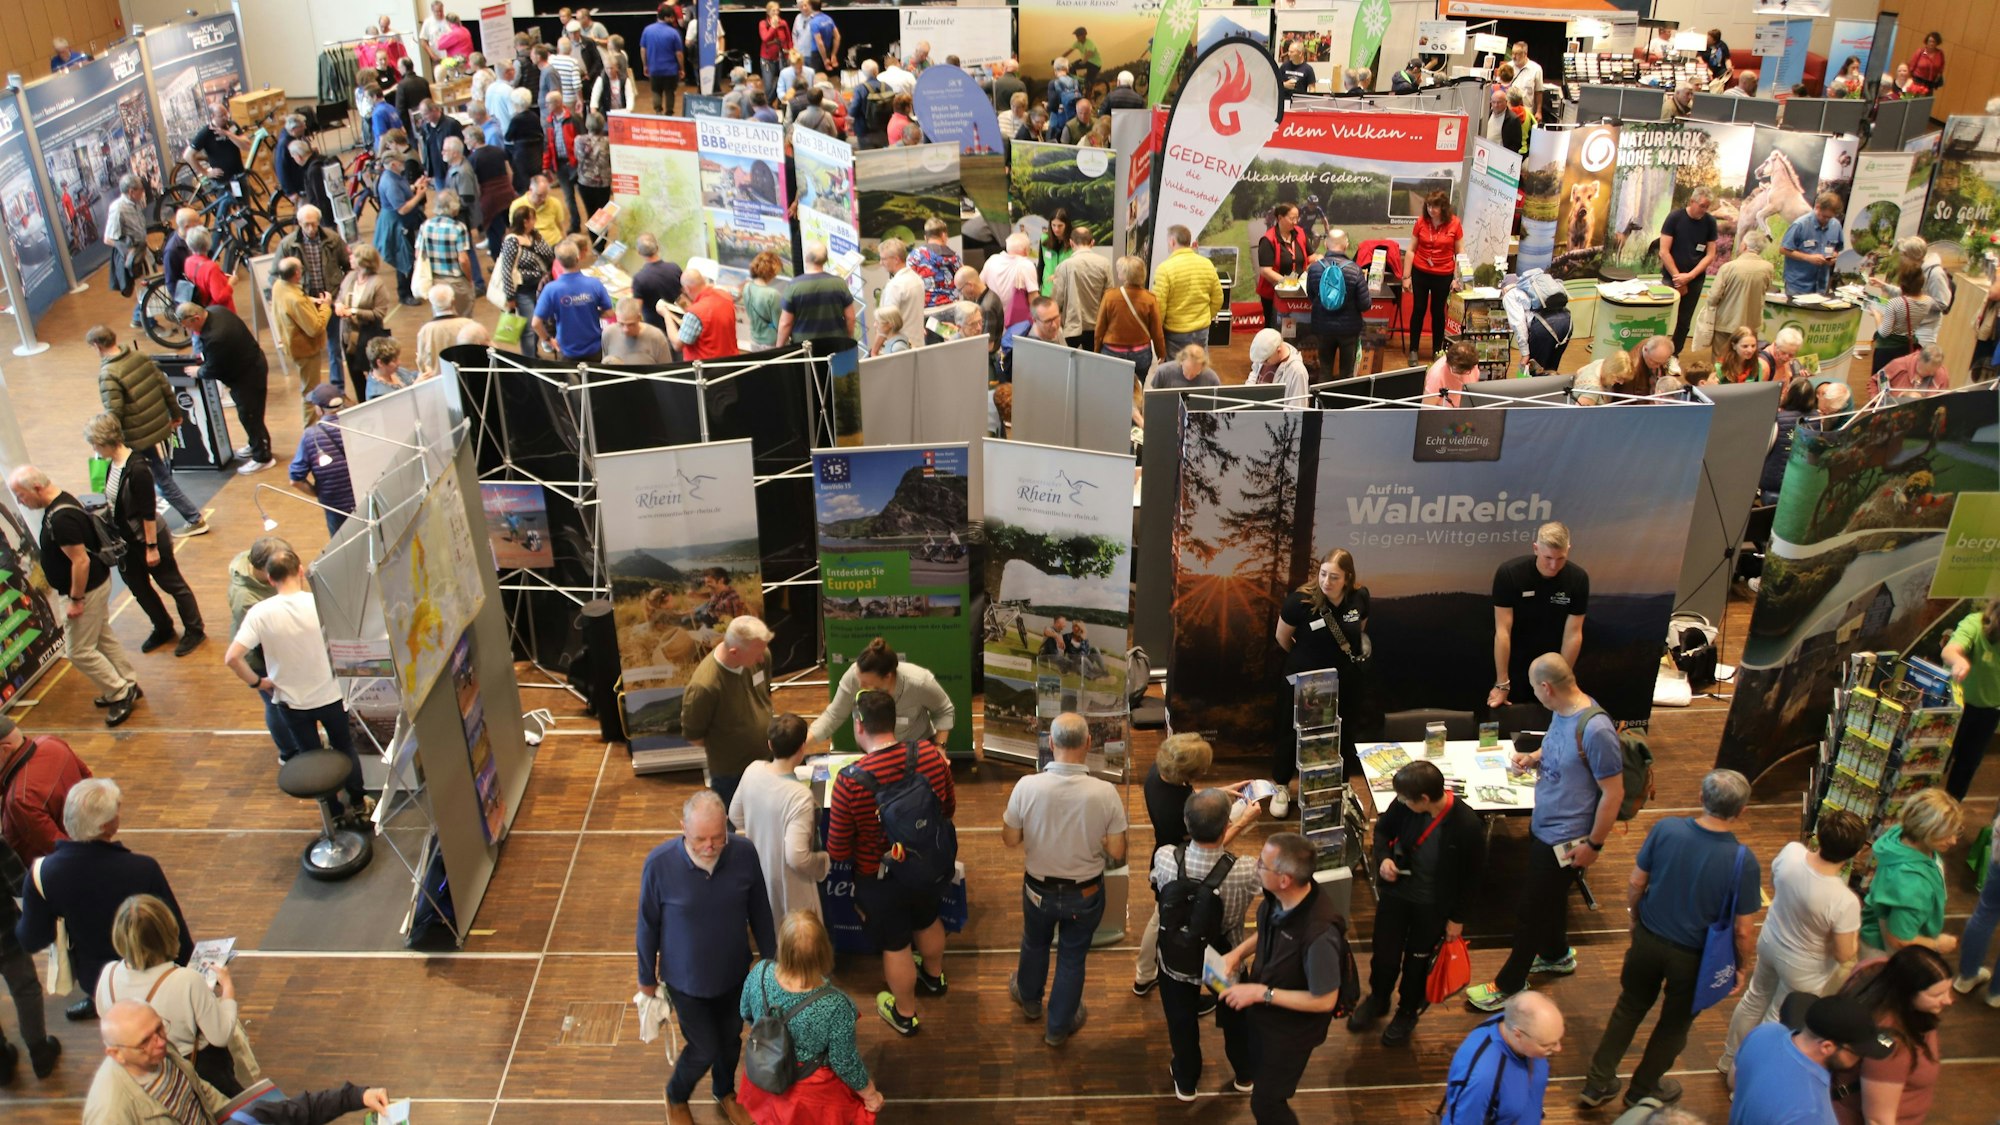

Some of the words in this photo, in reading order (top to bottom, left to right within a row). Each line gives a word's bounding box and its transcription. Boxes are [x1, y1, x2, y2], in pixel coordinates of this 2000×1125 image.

[904, 11, 955, 26] Tambiente
[192, 31, 225, 49] FELD
[113, 60, 136, 81] FELD
[701, 122, 721, 135] Das
[725, 126, 779, 143] 3B-LAND
[1283, 124, 1326, 138] dem
[1331, 123, 1406, 140] Vulkan
[1618, 131, 1702, 148] NATURPARK
[701, 135, 779, 158] BBBegeistert
[795, 132, 811, 145] Das
[813, 140, 849, 162] 3B-LAND
[1168, 144, 1243, 180] GEDERN
[1617, 148, 1653, 166] HOHE
[1658, 149, 1700, 166] MARK
[1185, 169, 1202, 182] die
[1238, 171, 1317, 184] ulkanstadt
[1319, 171, 1373, 184] Gedern
[1164, 177, 1220, 205] Vulkanstadt
[1933, 200, 1952, 220] So
[1956, 203, 1993, 224] geht
[1807, 334, 1830, 344] HOHE
[1425, 436, 1446, 446] Echt
[828, 465, 843, 475] 15
[1017, 485, 1062, 504] Rhein
[1366, 484, 1392, 495] Auf
[1394, 484, 1414, 494] ins
[635, 490, 682, 509] Rhein
[1346, 491, 1553, 525] WaldReich
[1349, 528, 1538, 548] Siegen-Wittgenstei
[826, 567, 870, 577] Entdecken
[871, 567, 885, 575] Sie
[827, 577, 877, 592] Europa!
